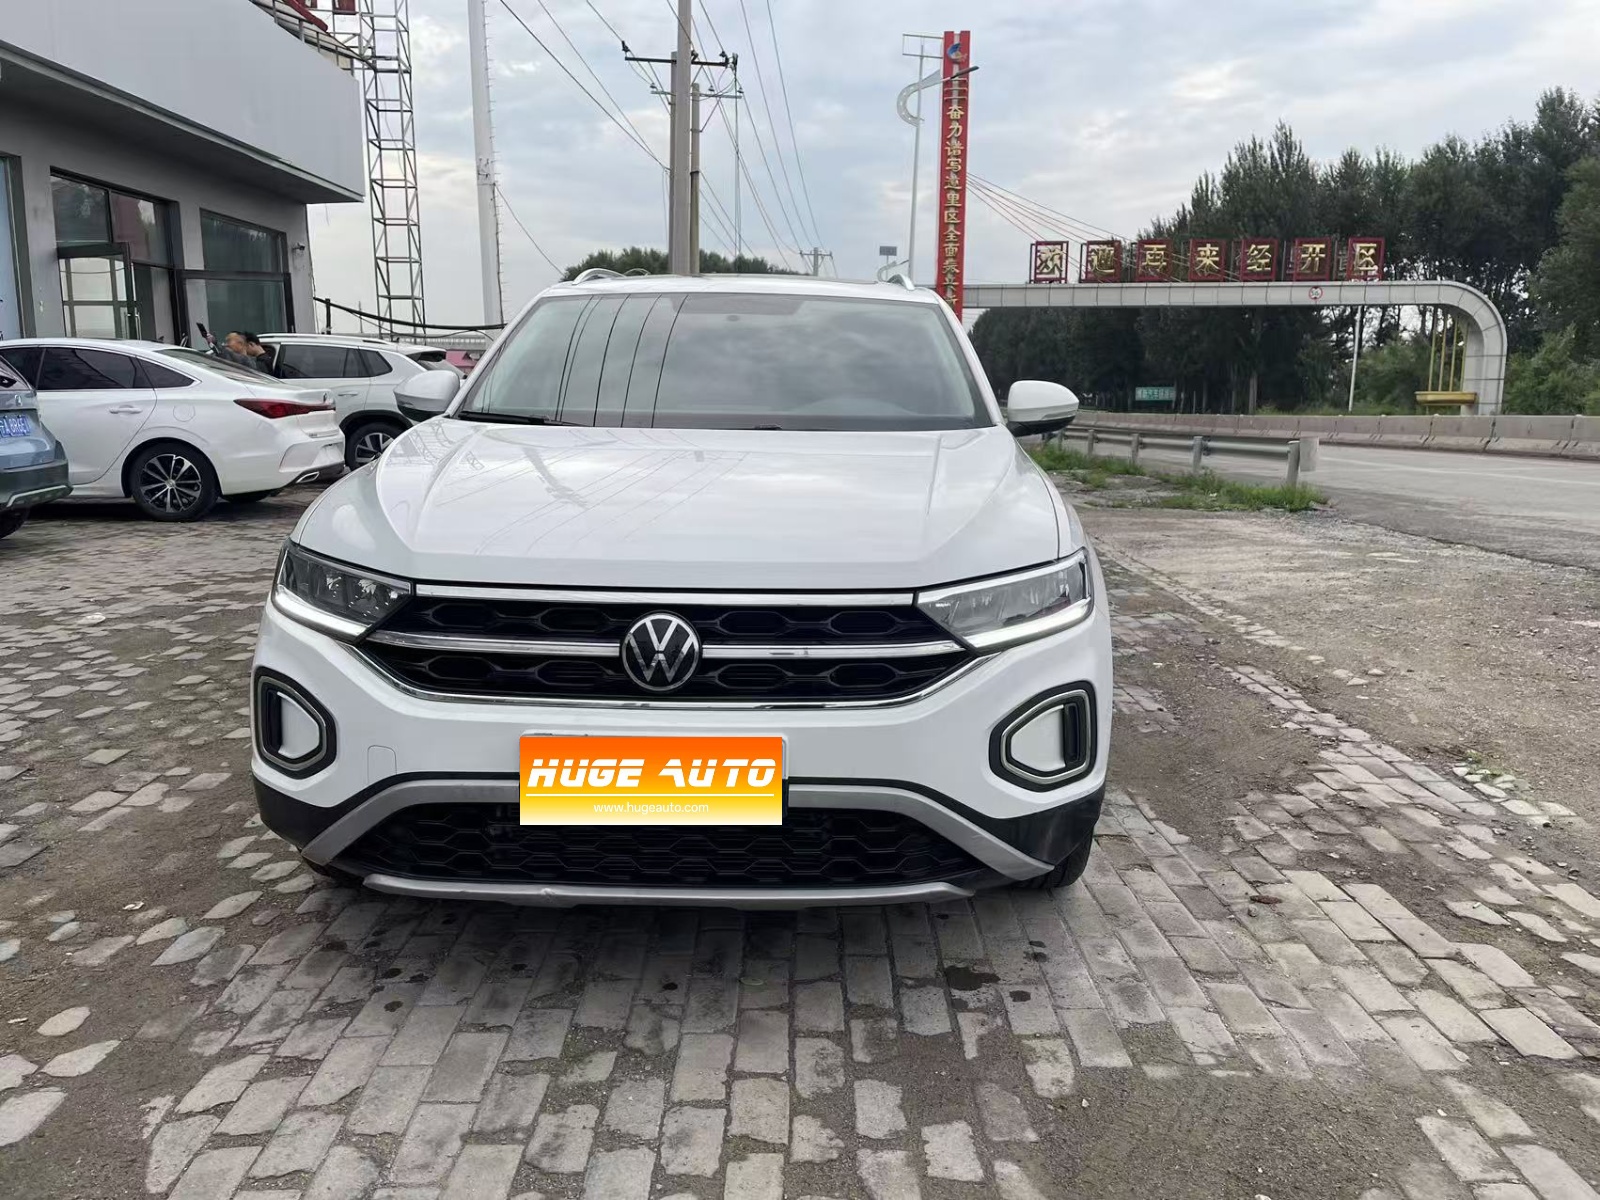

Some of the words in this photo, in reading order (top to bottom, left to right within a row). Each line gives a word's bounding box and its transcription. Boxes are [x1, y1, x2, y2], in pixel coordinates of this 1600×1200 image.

[1036, 243, 1378, 277] 欢迎再来经开区
